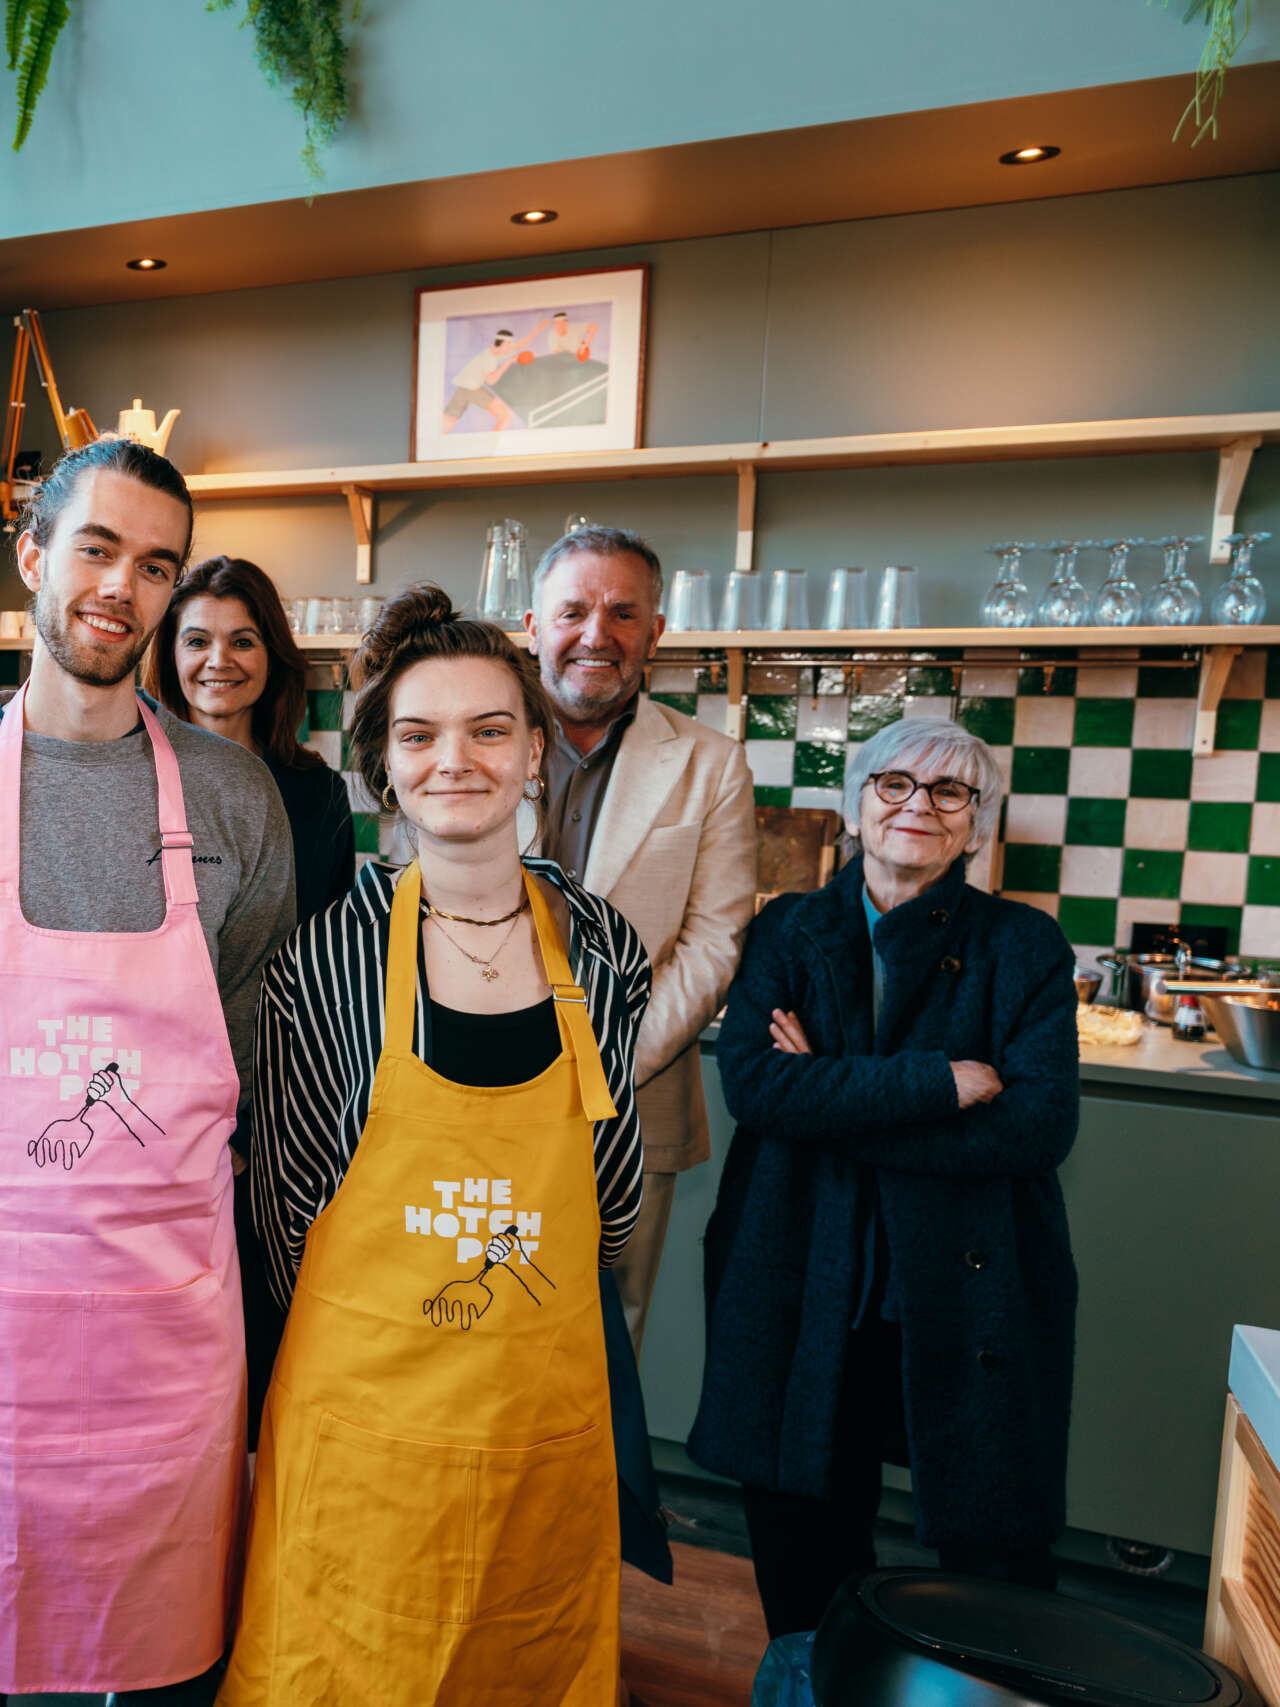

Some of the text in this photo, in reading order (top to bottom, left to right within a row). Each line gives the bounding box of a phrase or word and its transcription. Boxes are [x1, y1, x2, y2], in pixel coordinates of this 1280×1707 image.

[37, 1015, 113, 1046] THE
[10, 1044, 142, 1075] HOTCH
[433, 1177, 512, 1209] THE
[405, 1205, 542, 1238] HOTCH
